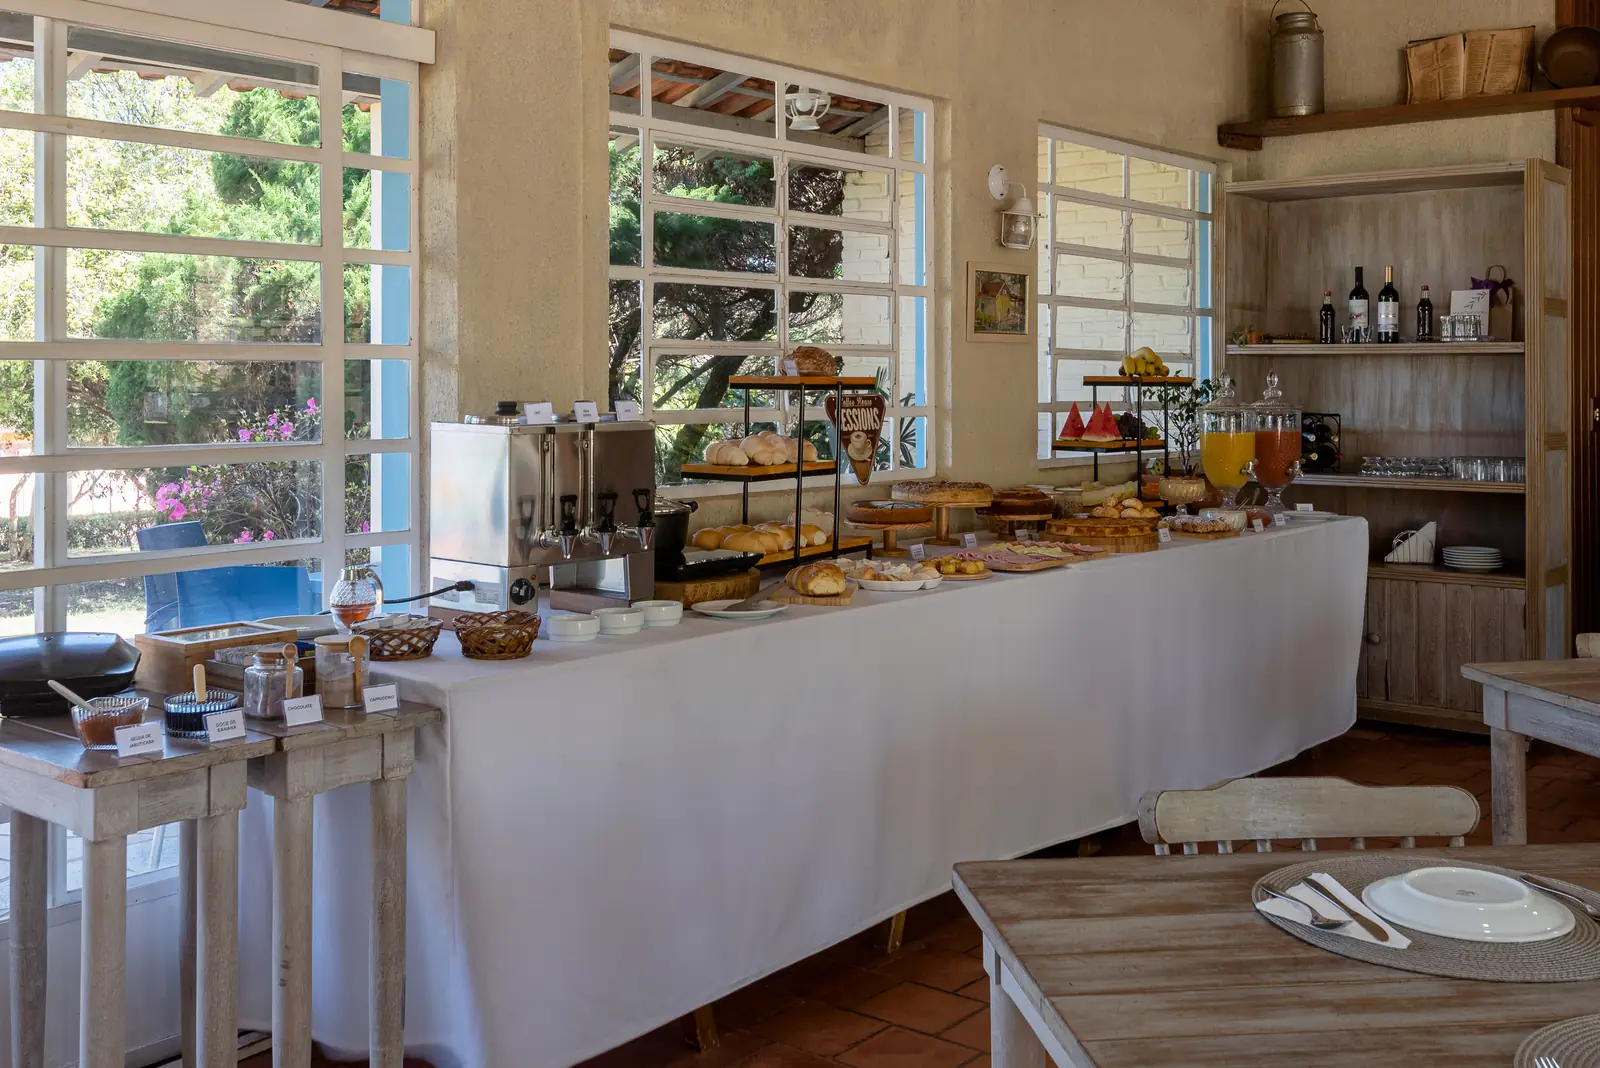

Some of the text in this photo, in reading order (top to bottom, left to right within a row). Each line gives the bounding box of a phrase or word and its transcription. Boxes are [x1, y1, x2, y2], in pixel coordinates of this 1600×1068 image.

[841, 397, 855, 407] offee
[370, 695, 394, 703] CAPPUCCINO
[288, 703, 312, 711] CHOCOLATE
[129, 740, 154, 748] JABUTICABA
